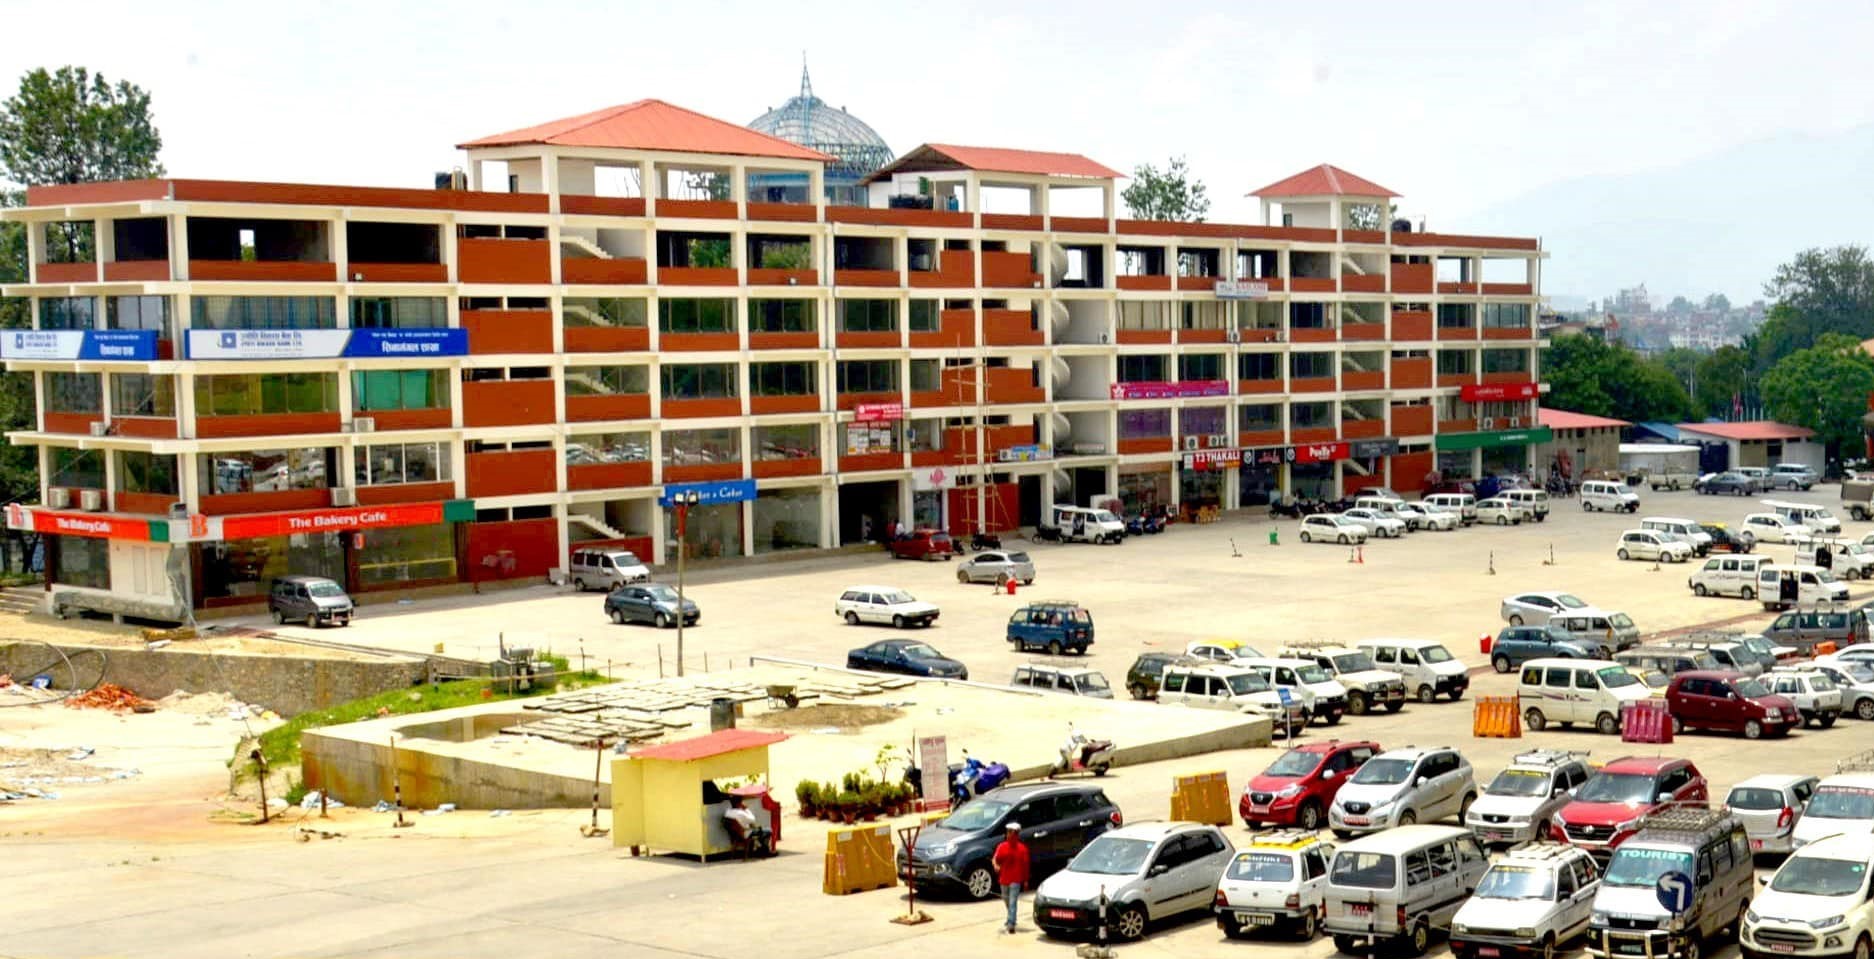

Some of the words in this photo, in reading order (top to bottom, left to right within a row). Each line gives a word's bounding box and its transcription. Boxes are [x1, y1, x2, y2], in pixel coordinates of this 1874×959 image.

[1206, 451, 1240, 462] THAKALI
[56, 517, 68, 528] The
[69, 518, 95, 533] Bakery
[95, 521, 111, 533] Cafe
[289, 517, 311, 528] The
[314, 513, 357, 528] Bakery
[359, 511, 386, 523] Cafe
[1620, 849, 1689, 861] TOURIST
